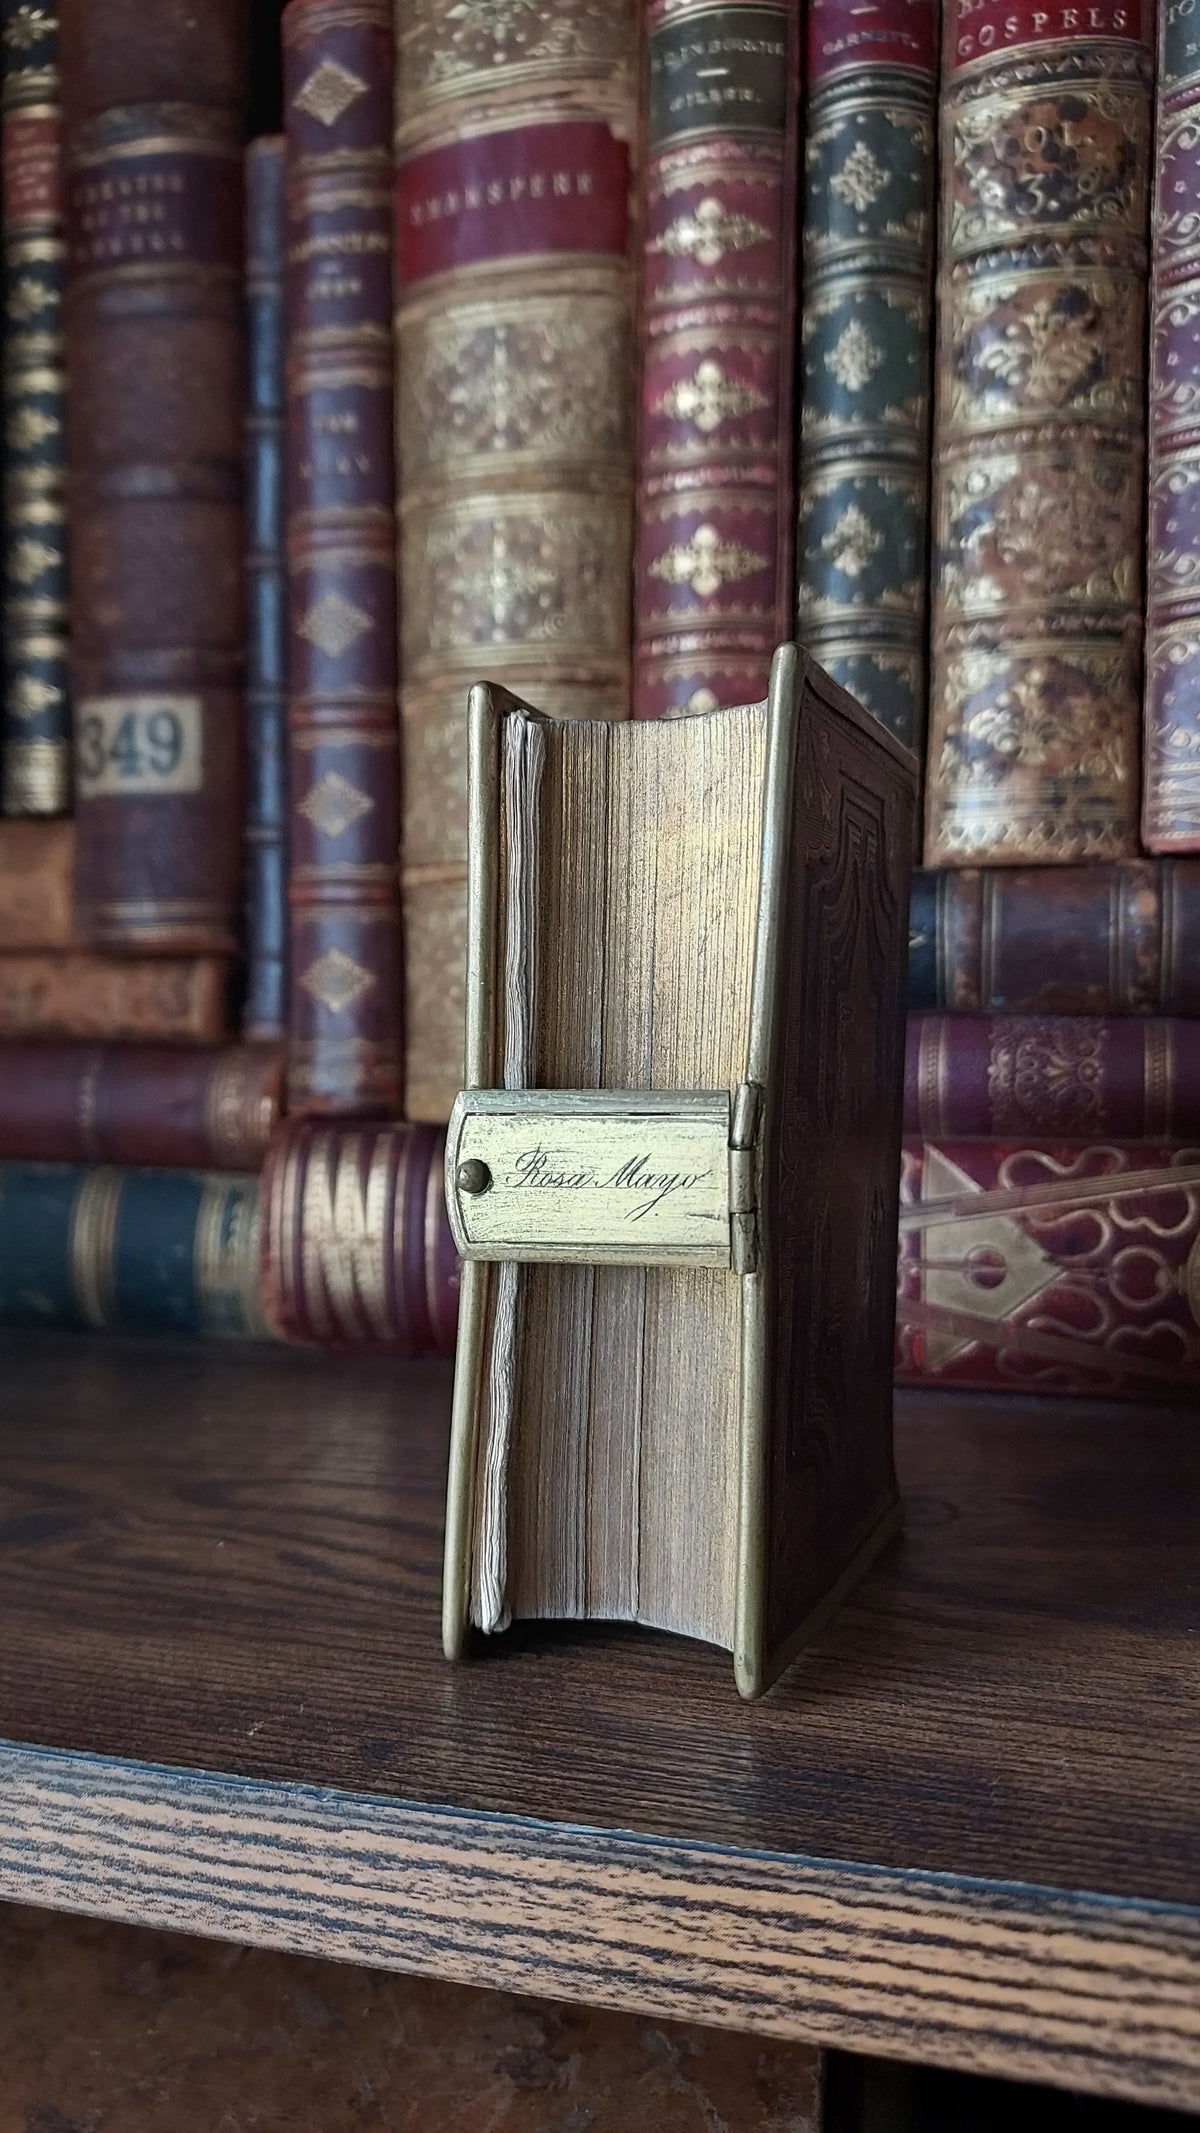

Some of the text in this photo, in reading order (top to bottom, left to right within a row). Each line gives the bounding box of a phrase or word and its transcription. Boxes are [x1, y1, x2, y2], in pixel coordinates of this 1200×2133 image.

[957, 8, 1128, 57] GOSPELS
[75, 708, 184, 781] 349
[505, 1141, 714, 1224] Rosa Mayo
